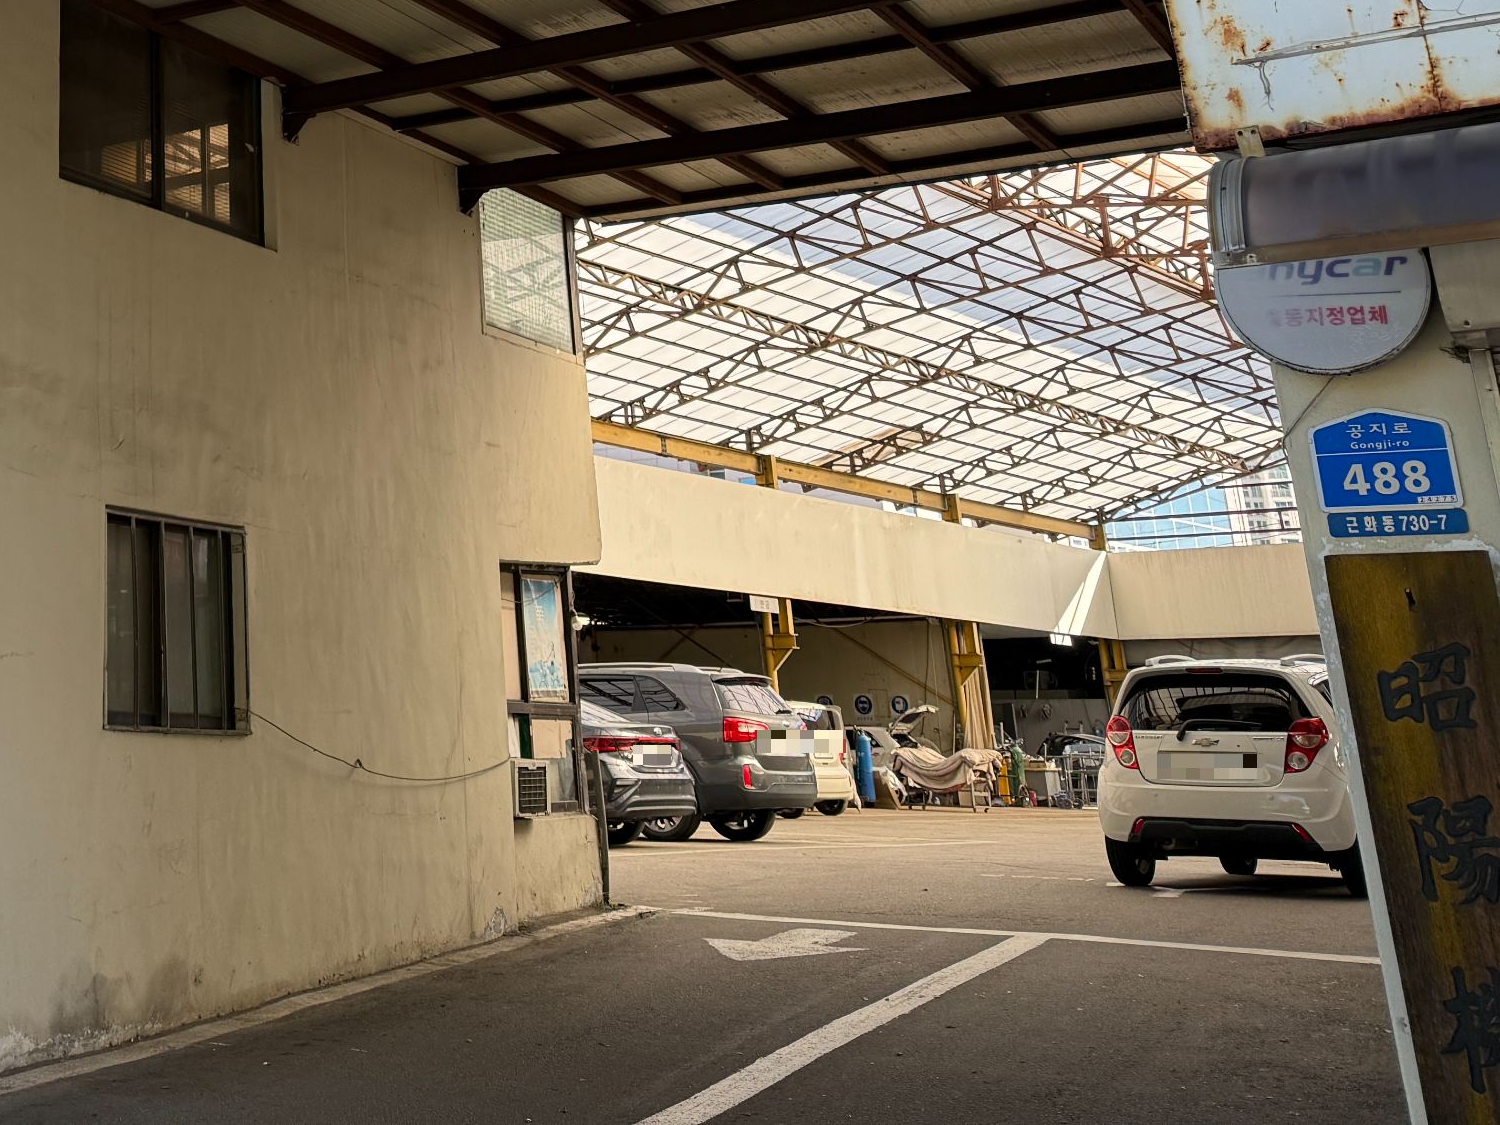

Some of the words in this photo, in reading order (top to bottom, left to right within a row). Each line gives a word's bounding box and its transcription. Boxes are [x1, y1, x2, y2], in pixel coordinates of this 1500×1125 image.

[1256, 256, 1408, 286] nycar
[1346, 422, 1412, 439] 공지로
[1350, 440, 1410, 450] Gongji-ro
[1343, 460, 1431, 496] 488
[1346, 515, 1396, 534] 근화동
[1399, 514, 1447, 531] 730-7
